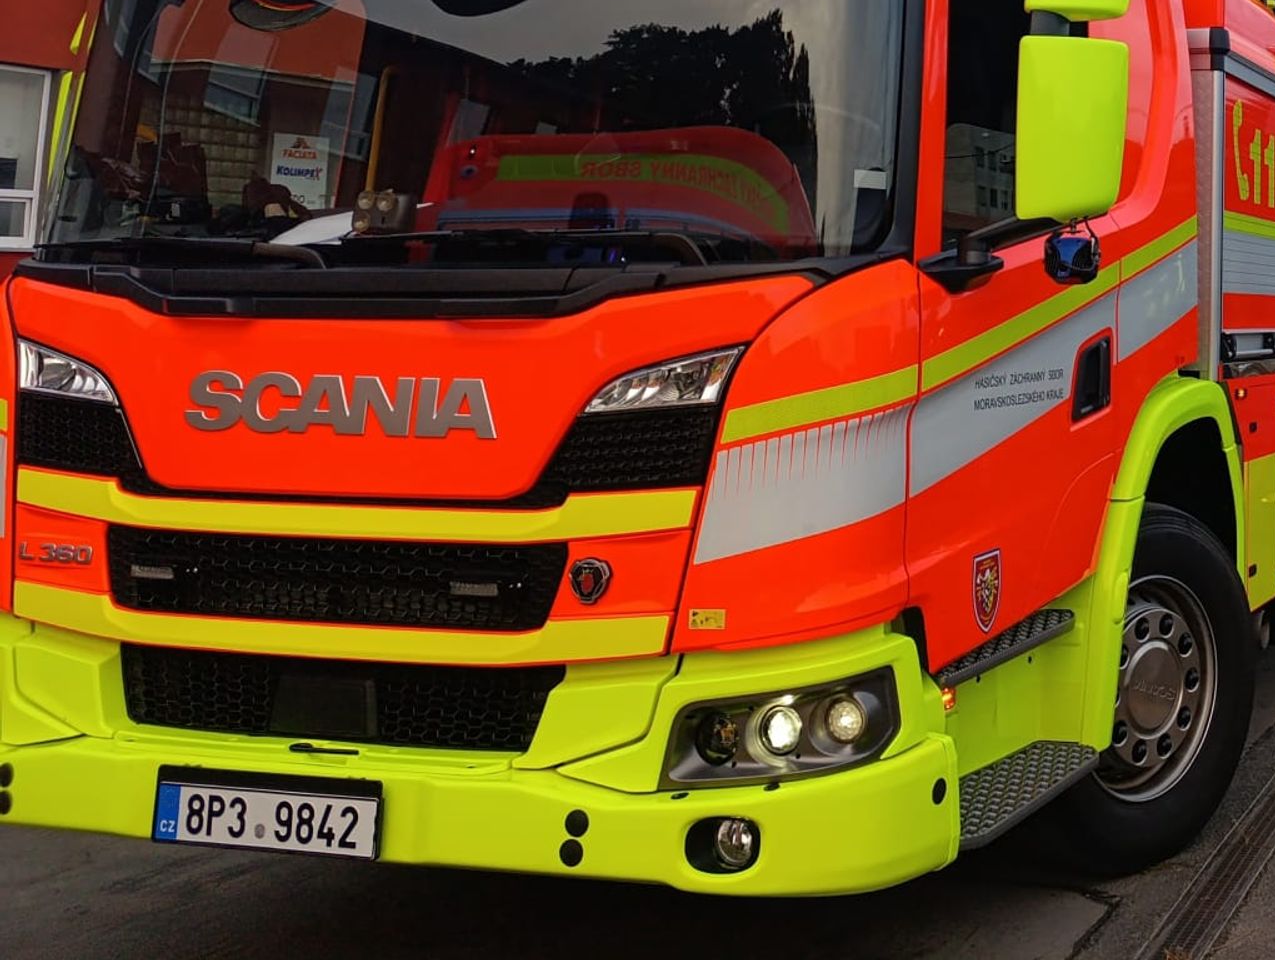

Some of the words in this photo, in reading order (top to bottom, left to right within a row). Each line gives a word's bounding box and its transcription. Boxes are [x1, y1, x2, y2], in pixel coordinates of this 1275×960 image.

[184, 370, 497, 439] SCANIA
[19, 541, 34, 560] L
[39, 543, 93, 565] 360
[159, 820, 175, 833] CZ
[186, 793, 248, 839] 8P3
[274, 800, 359, 850] 9842
